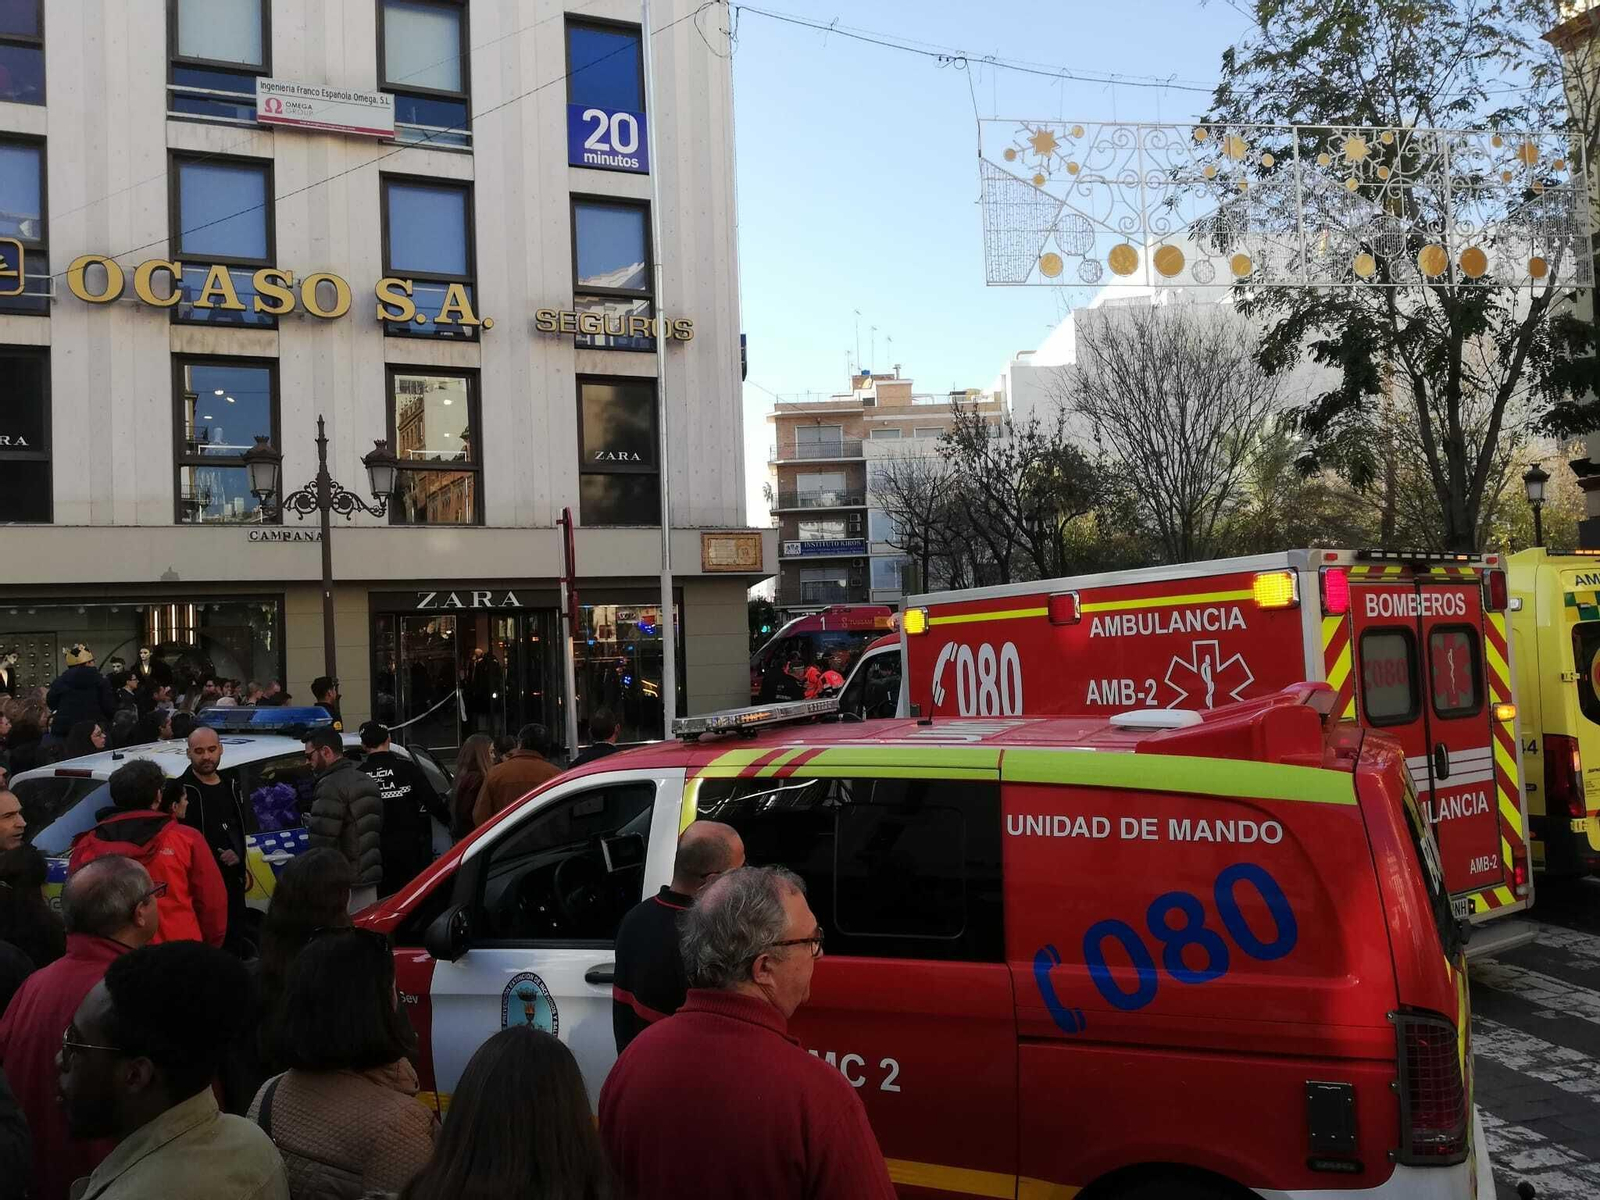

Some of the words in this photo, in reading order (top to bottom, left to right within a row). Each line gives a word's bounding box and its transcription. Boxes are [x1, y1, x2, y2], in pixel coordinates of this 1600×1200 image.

[297, 86, 320, 97] Franco
[285, 101, 313, 110] OMEGA
[582, 108, 639, 154] 20
[584, 151, 639, 168] minutos
[66, 254, 353, 318] OCASO
[375, 277, 495, 330] S.A.
[535, 308, 695, 341] SEGUROS
[594, 451, 641, 461] ZARA
[249, 530, 323, 541] CAMPANA
[1575, 573, 1600, 587] AM
[417, 590, 523, 609] ZARA
[1365, 592, 1466, 617] BOMBEROS
[820, 616, 826, 630] 1
[1090, 606, 1247, 637] AMBULANCIA
[956, 641, 1023, 717] 080
[1086, 678, 1158, 706] AMB-2
[1423, 791, 1490, 824] LANCIA
[1006, 814, 1111, 838] UNIDAD
[1120, 817, 1159, 840] DE
[1168, 818, 1283, 844] MANDO
[1470, 854, 1498, 875] AMB-2
[1451, 900, 1467, 917] NH
[1082, 862, 1298, 1012] 080
[880, 1058, 900, 1092] 2
